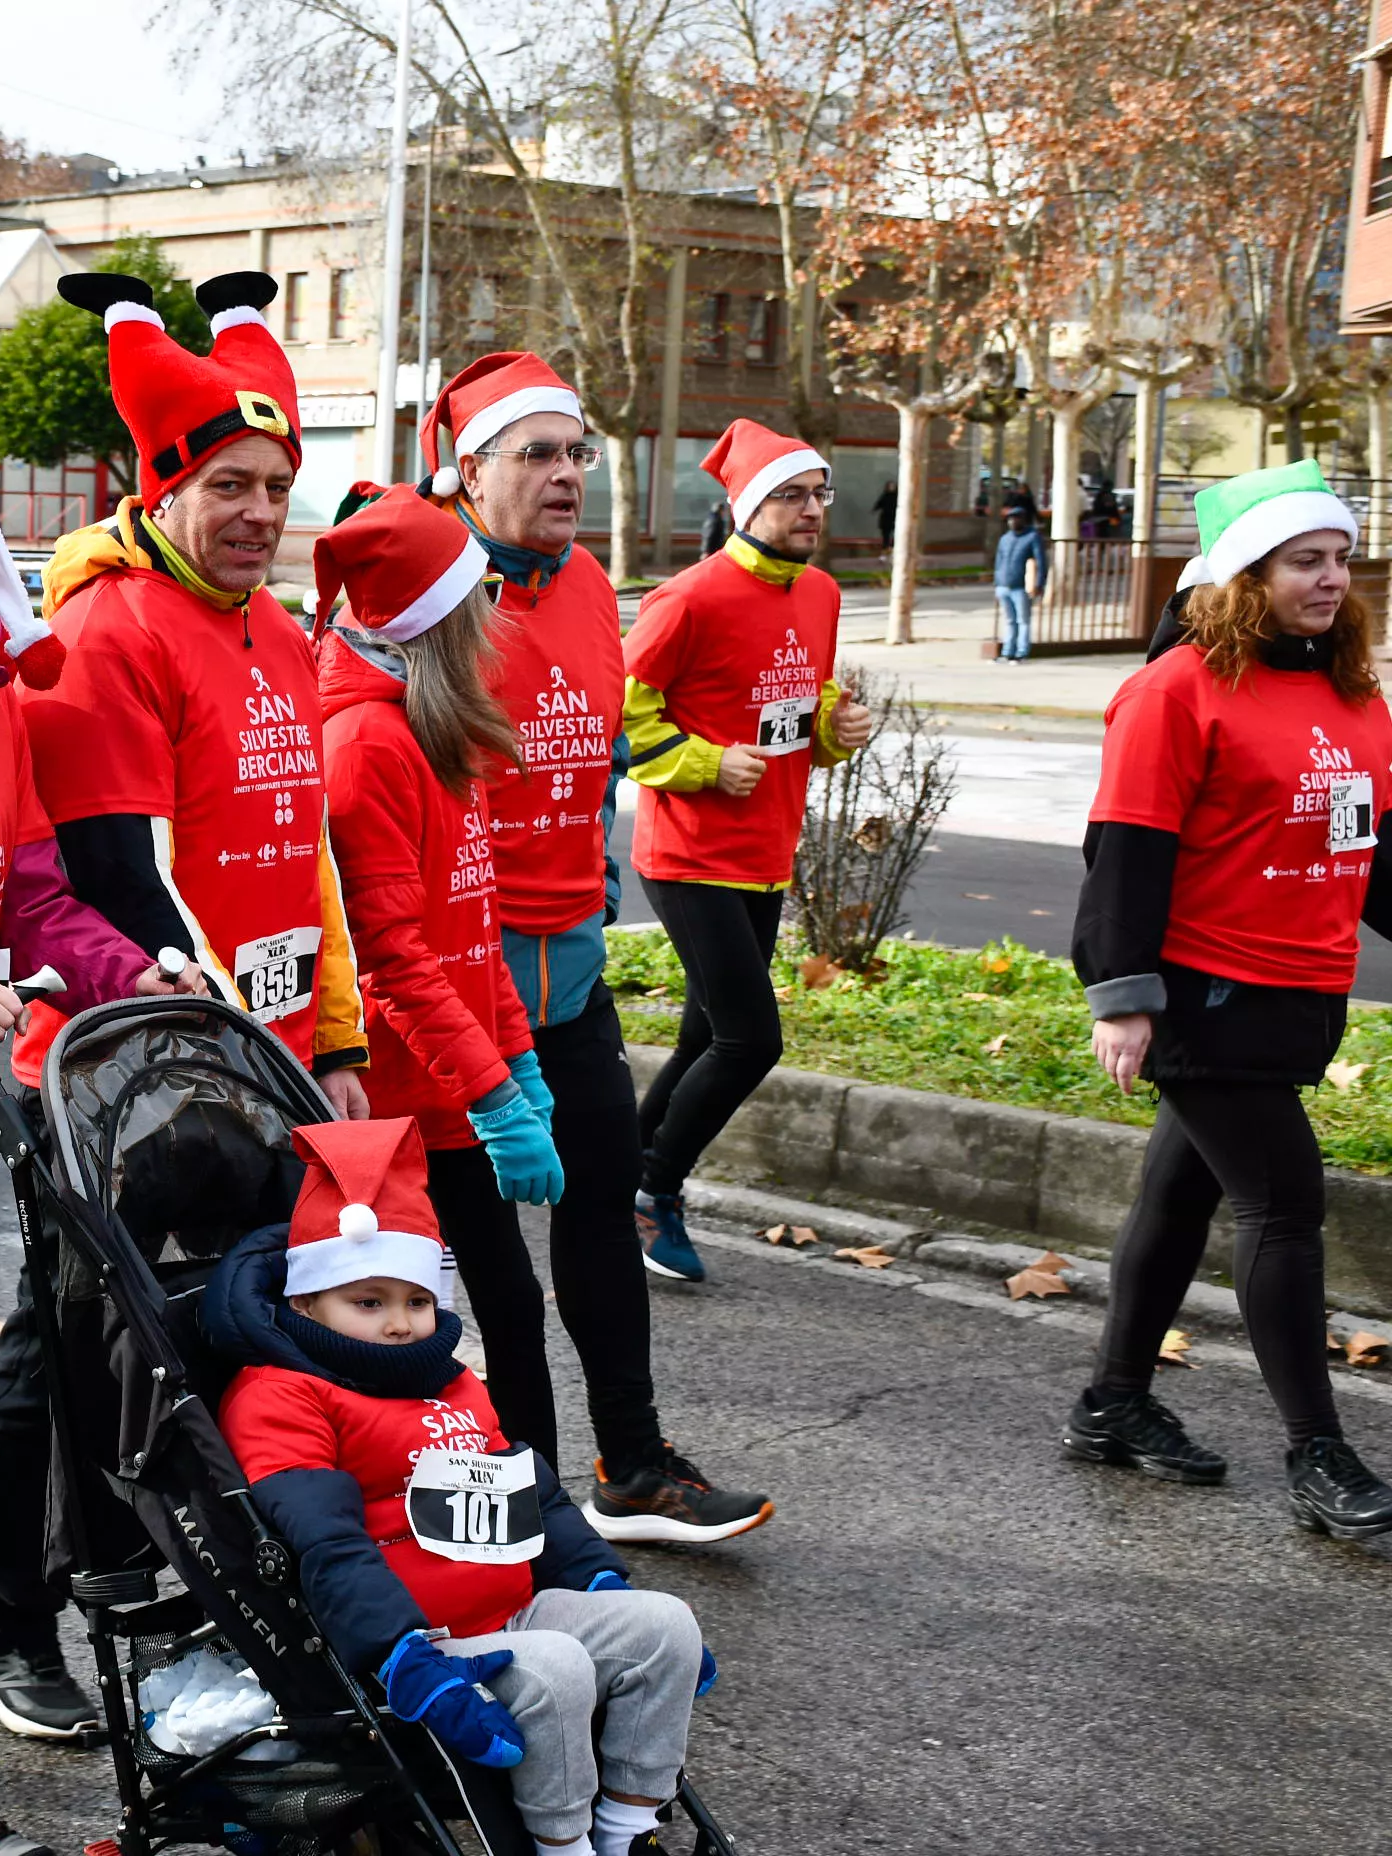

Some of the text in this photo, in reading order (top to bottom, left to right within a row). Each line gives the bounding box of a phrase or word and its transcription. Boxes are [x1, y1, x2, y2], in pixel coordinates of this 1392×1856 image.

[773, 647, 808, 667] SAN
[759, 666, 816, 685] SILVESTRE
[537, 689, 588, 717] SAN
[751, 682, 817, 702] BERCIANA
[245, 693, 296, 725] SAN
[239, 725, 311, 753] SILVESTRE
[519, 715, 604, 741] SILVESTRE
[238, 749, 318, 781] BERCIANA
[1309, 747, 1352, 770] SAN
[1331, 805, 1358, 840] 99
[251, 958, 299, 1010] 859
[19, 1199, 29, 1233] techno
[422, 1408, 481, 1439] SAN
[448, 1457, 503, 1471] SAN SILVESTRE
